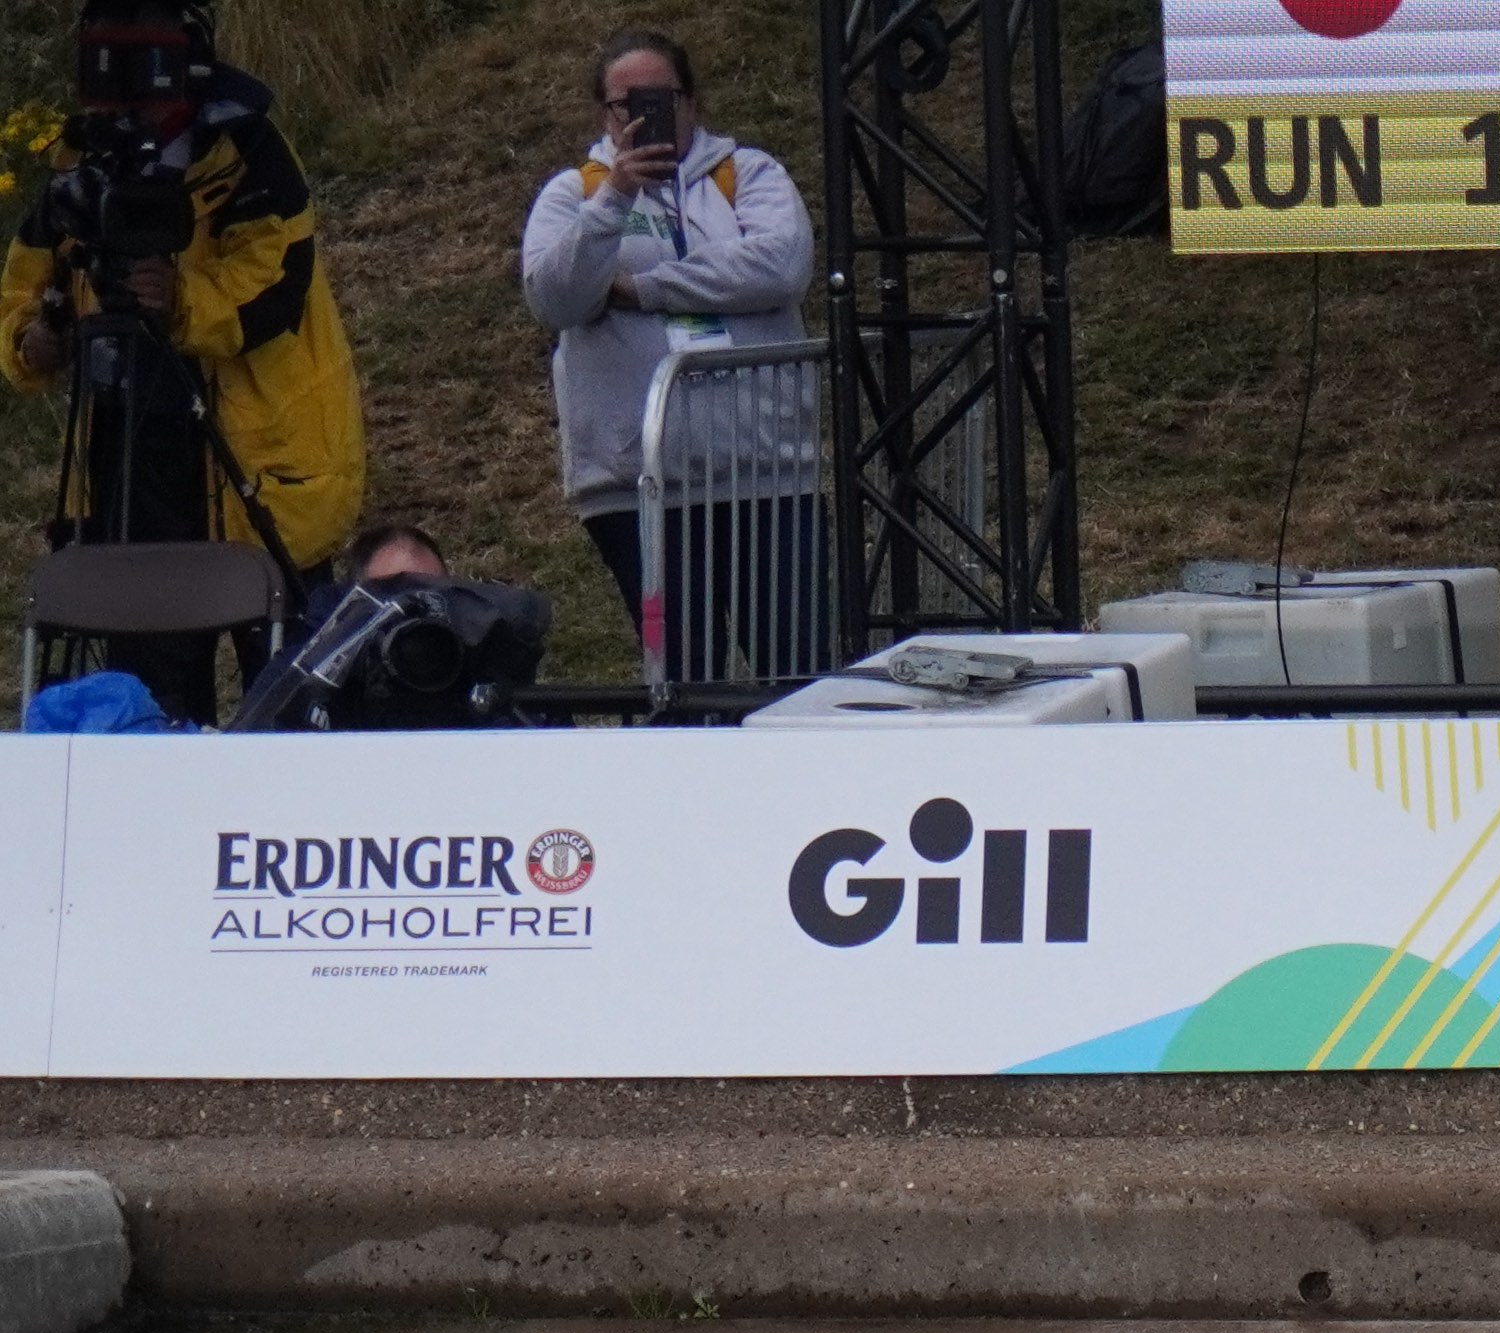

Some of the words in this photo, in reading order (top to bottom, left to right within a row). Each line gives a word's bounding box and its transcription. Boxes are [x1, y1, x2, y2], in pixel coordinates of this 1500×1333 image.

[1179, 114, 1383, 211] RUN
[214, 832, 521, 897] ERDINGER
[531, 832, 591, 858] ERDINGER
[788, 797, 1093, 948] Gill
[211, 906, 592, 940] ALKOHOLFREI
[311, 965, 399, 978] REGISTERED
[404, 964, 488, 977] TRADEMARK
